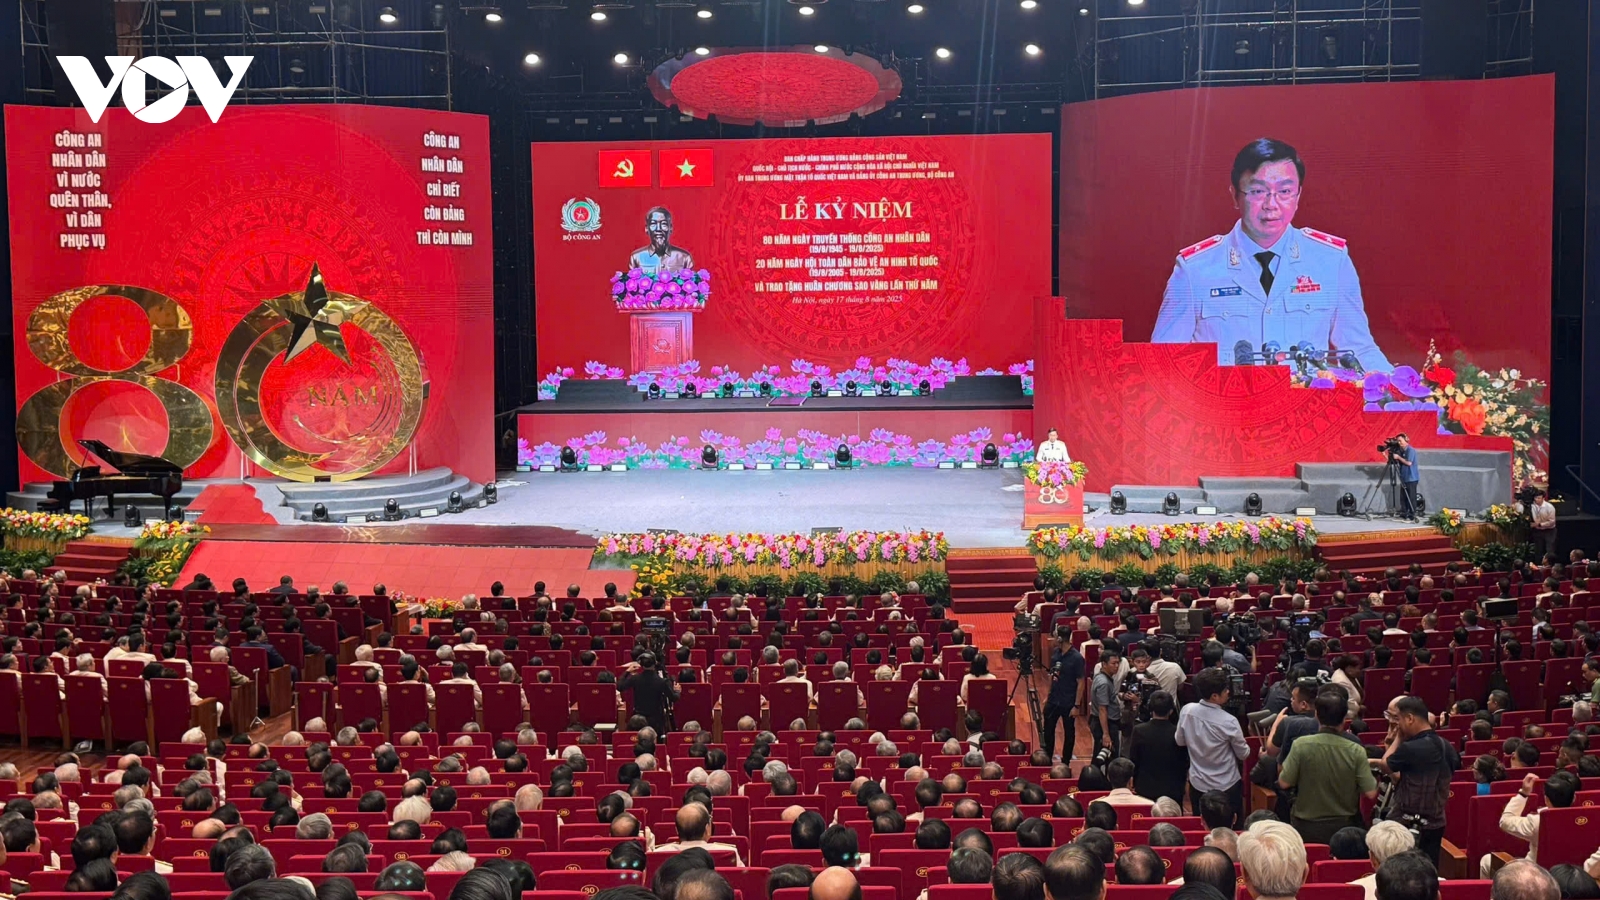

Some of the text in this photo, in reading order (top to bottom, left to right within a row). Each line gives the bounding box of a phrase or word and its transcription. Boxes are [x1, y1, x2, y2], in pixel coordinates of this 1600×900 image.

[55, 130, 102, 147] CÔNG AN
[423, 131, 460, 149] CÔNG AN
[51, 150, 106, 167] NHÂN DÂN
[421, 155, 463, 173] NHÂN DÂN
[56, 170, 101, 187] VÌ NƯỚC
[426, 179, 460, 197] CHỈ BIẾT
[50, 190, 112, 208] QUÊN THÂN,
[424, 203, 465, 221] CÒN ĐẢNG
[779, 196, 912, 222] LỄ KỶ NIỆM
[66, 210, 101, 227] VÌ DÂN
[60, 234, 106, 250] PHỤC VỤ
[416, 229, 473, 246] THÌ CÒN MÌNH
[763, 235, 773, 245] 80
[774, 234, 790, 244] NĂM
[792, 233, 810, 244] NGÀY
[839, 232, 862, 244] THỐNG
[863, 232, 882, 243] CÔNG
[884, 233, 894, 243] AN
[895, 231, 914, 242] NHÂN
[915, 231, 930, 242] DÂN
[809, 245, 843, 253] (19/8/1945
[849, 244, 884, 253] 19/8/2025)
[755, 281, 764, 292] VÀ
[765, 282, 783, 291] TRAO
[785, 280, 802, 293] TẶNG
[804, 280, 822, 291] HUÂN
[824, 281, 852, 291] CHƯƠNG
[854, 281, 868, 290] SAO
[870, 280, 888, 290] VÀNG
[905, 279, 919, 290] THỨ
[921, 278, 938, 290] NĂM
[1038, 486, 1069, 504] 80
[584, 886, 595, 894] 30
